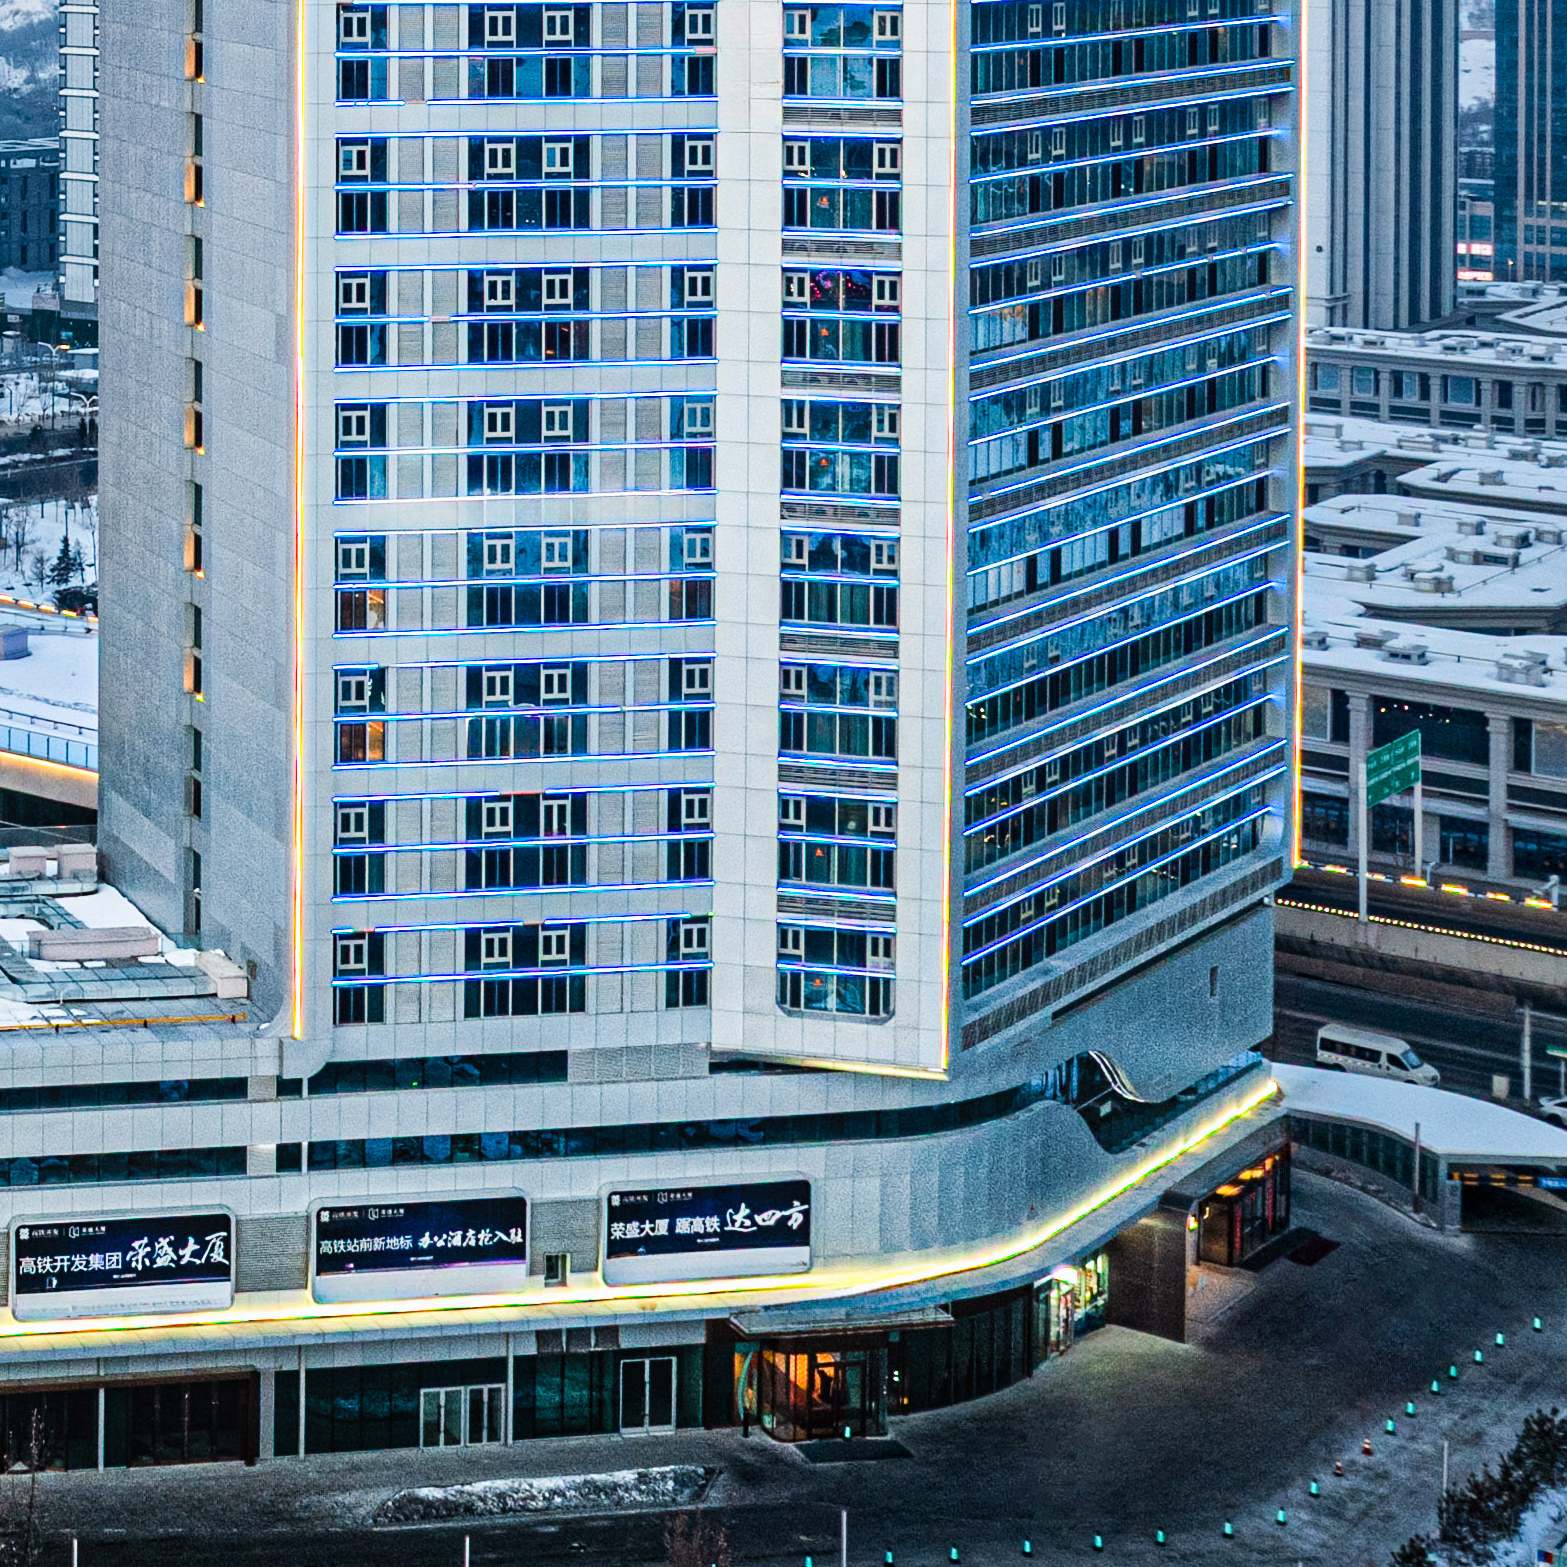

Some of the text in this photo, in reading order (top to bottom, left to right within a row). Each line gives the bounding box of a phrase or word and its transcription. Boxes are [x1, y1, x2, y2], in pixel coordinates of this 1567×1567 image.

[610, 1218, 669, 1240] 荣盛大厦
[724, 1200, 810, 1233] 达四方
[19, 1231, 230, 1275] 高铁开发集团 荣盛大厦
[319, 1235, 413, 1255] 高铁站前新地标
